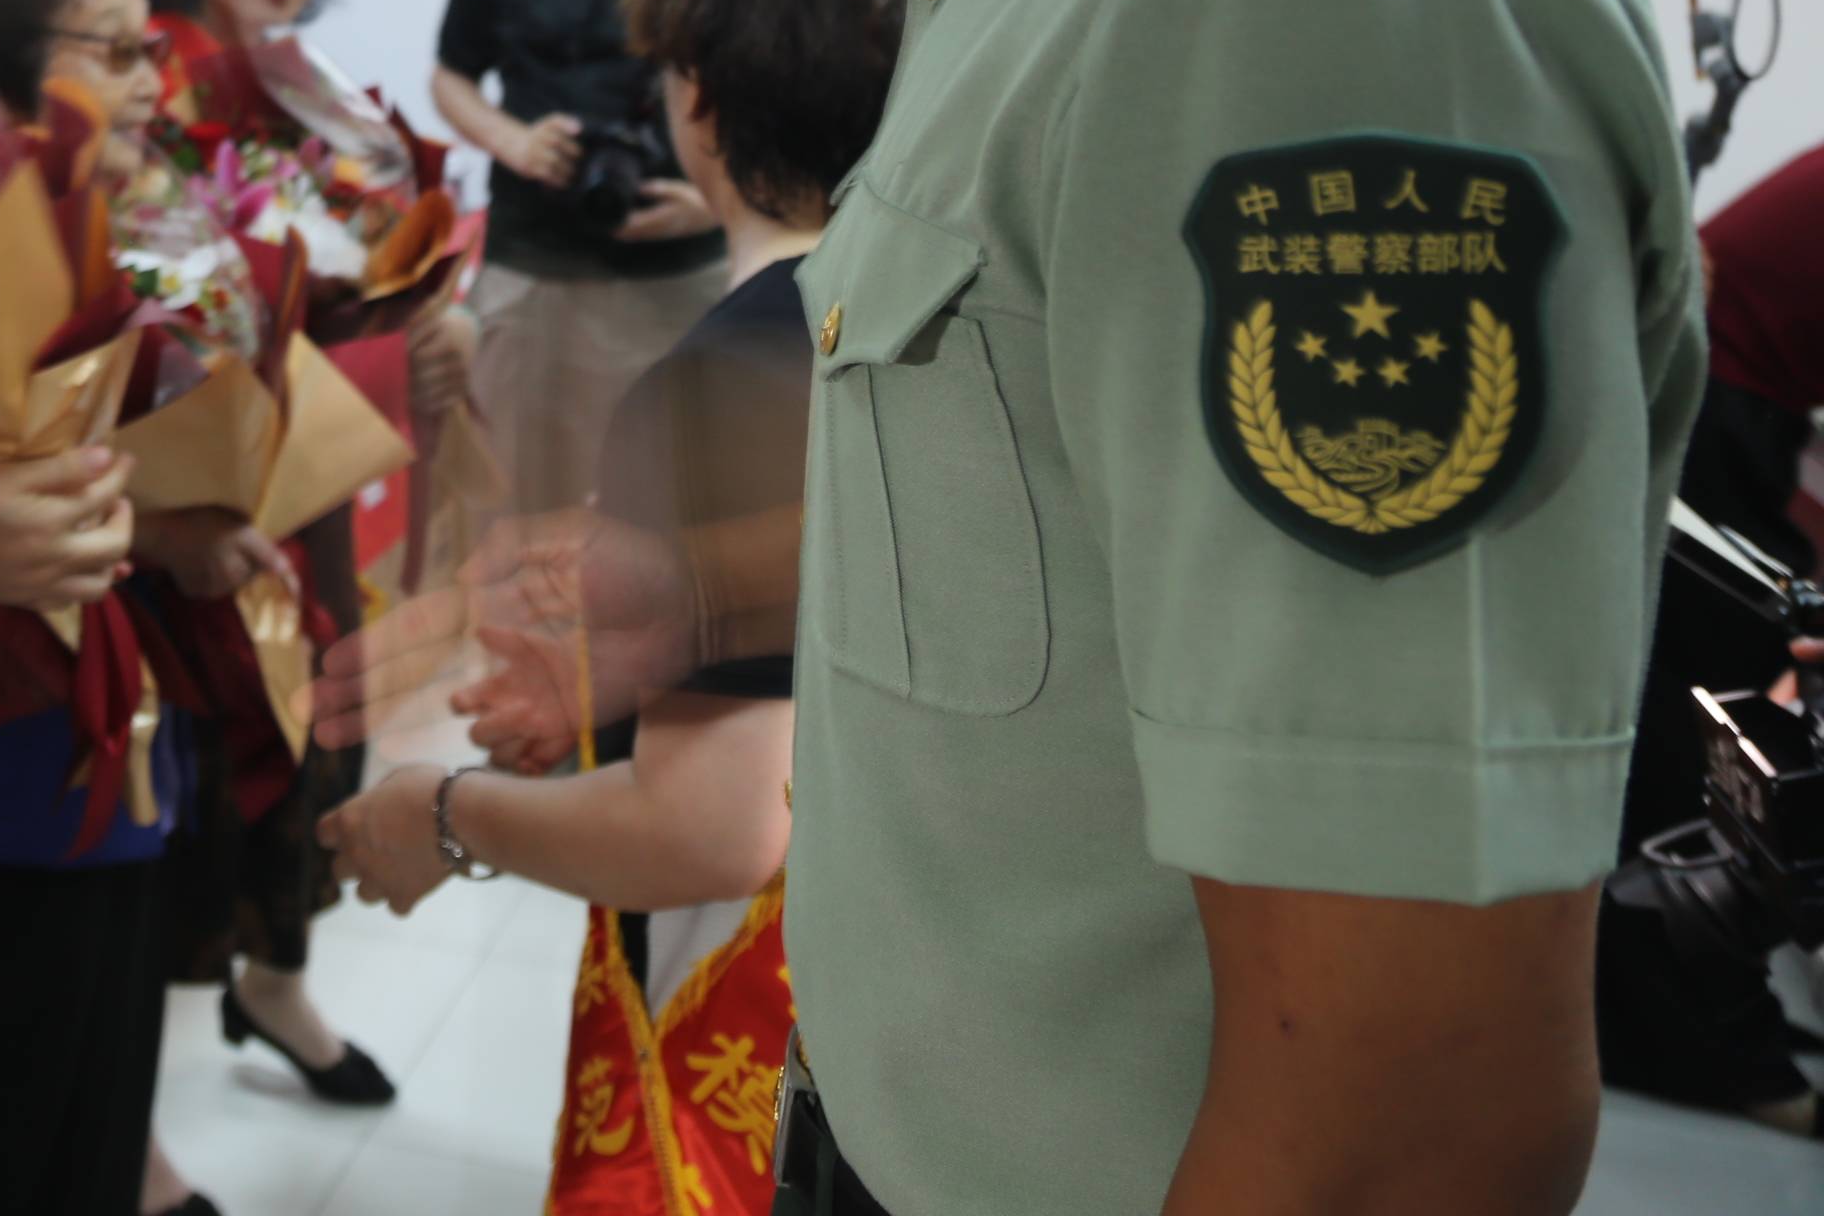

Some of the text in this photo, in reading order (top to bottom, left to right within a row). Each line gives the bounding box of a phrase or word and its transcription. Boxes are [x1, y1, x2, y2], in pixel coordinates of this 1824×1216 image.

[1235, 169, 1509, 227] 中国人民
[1236, 231, 1509, 275] 武装警察部队
